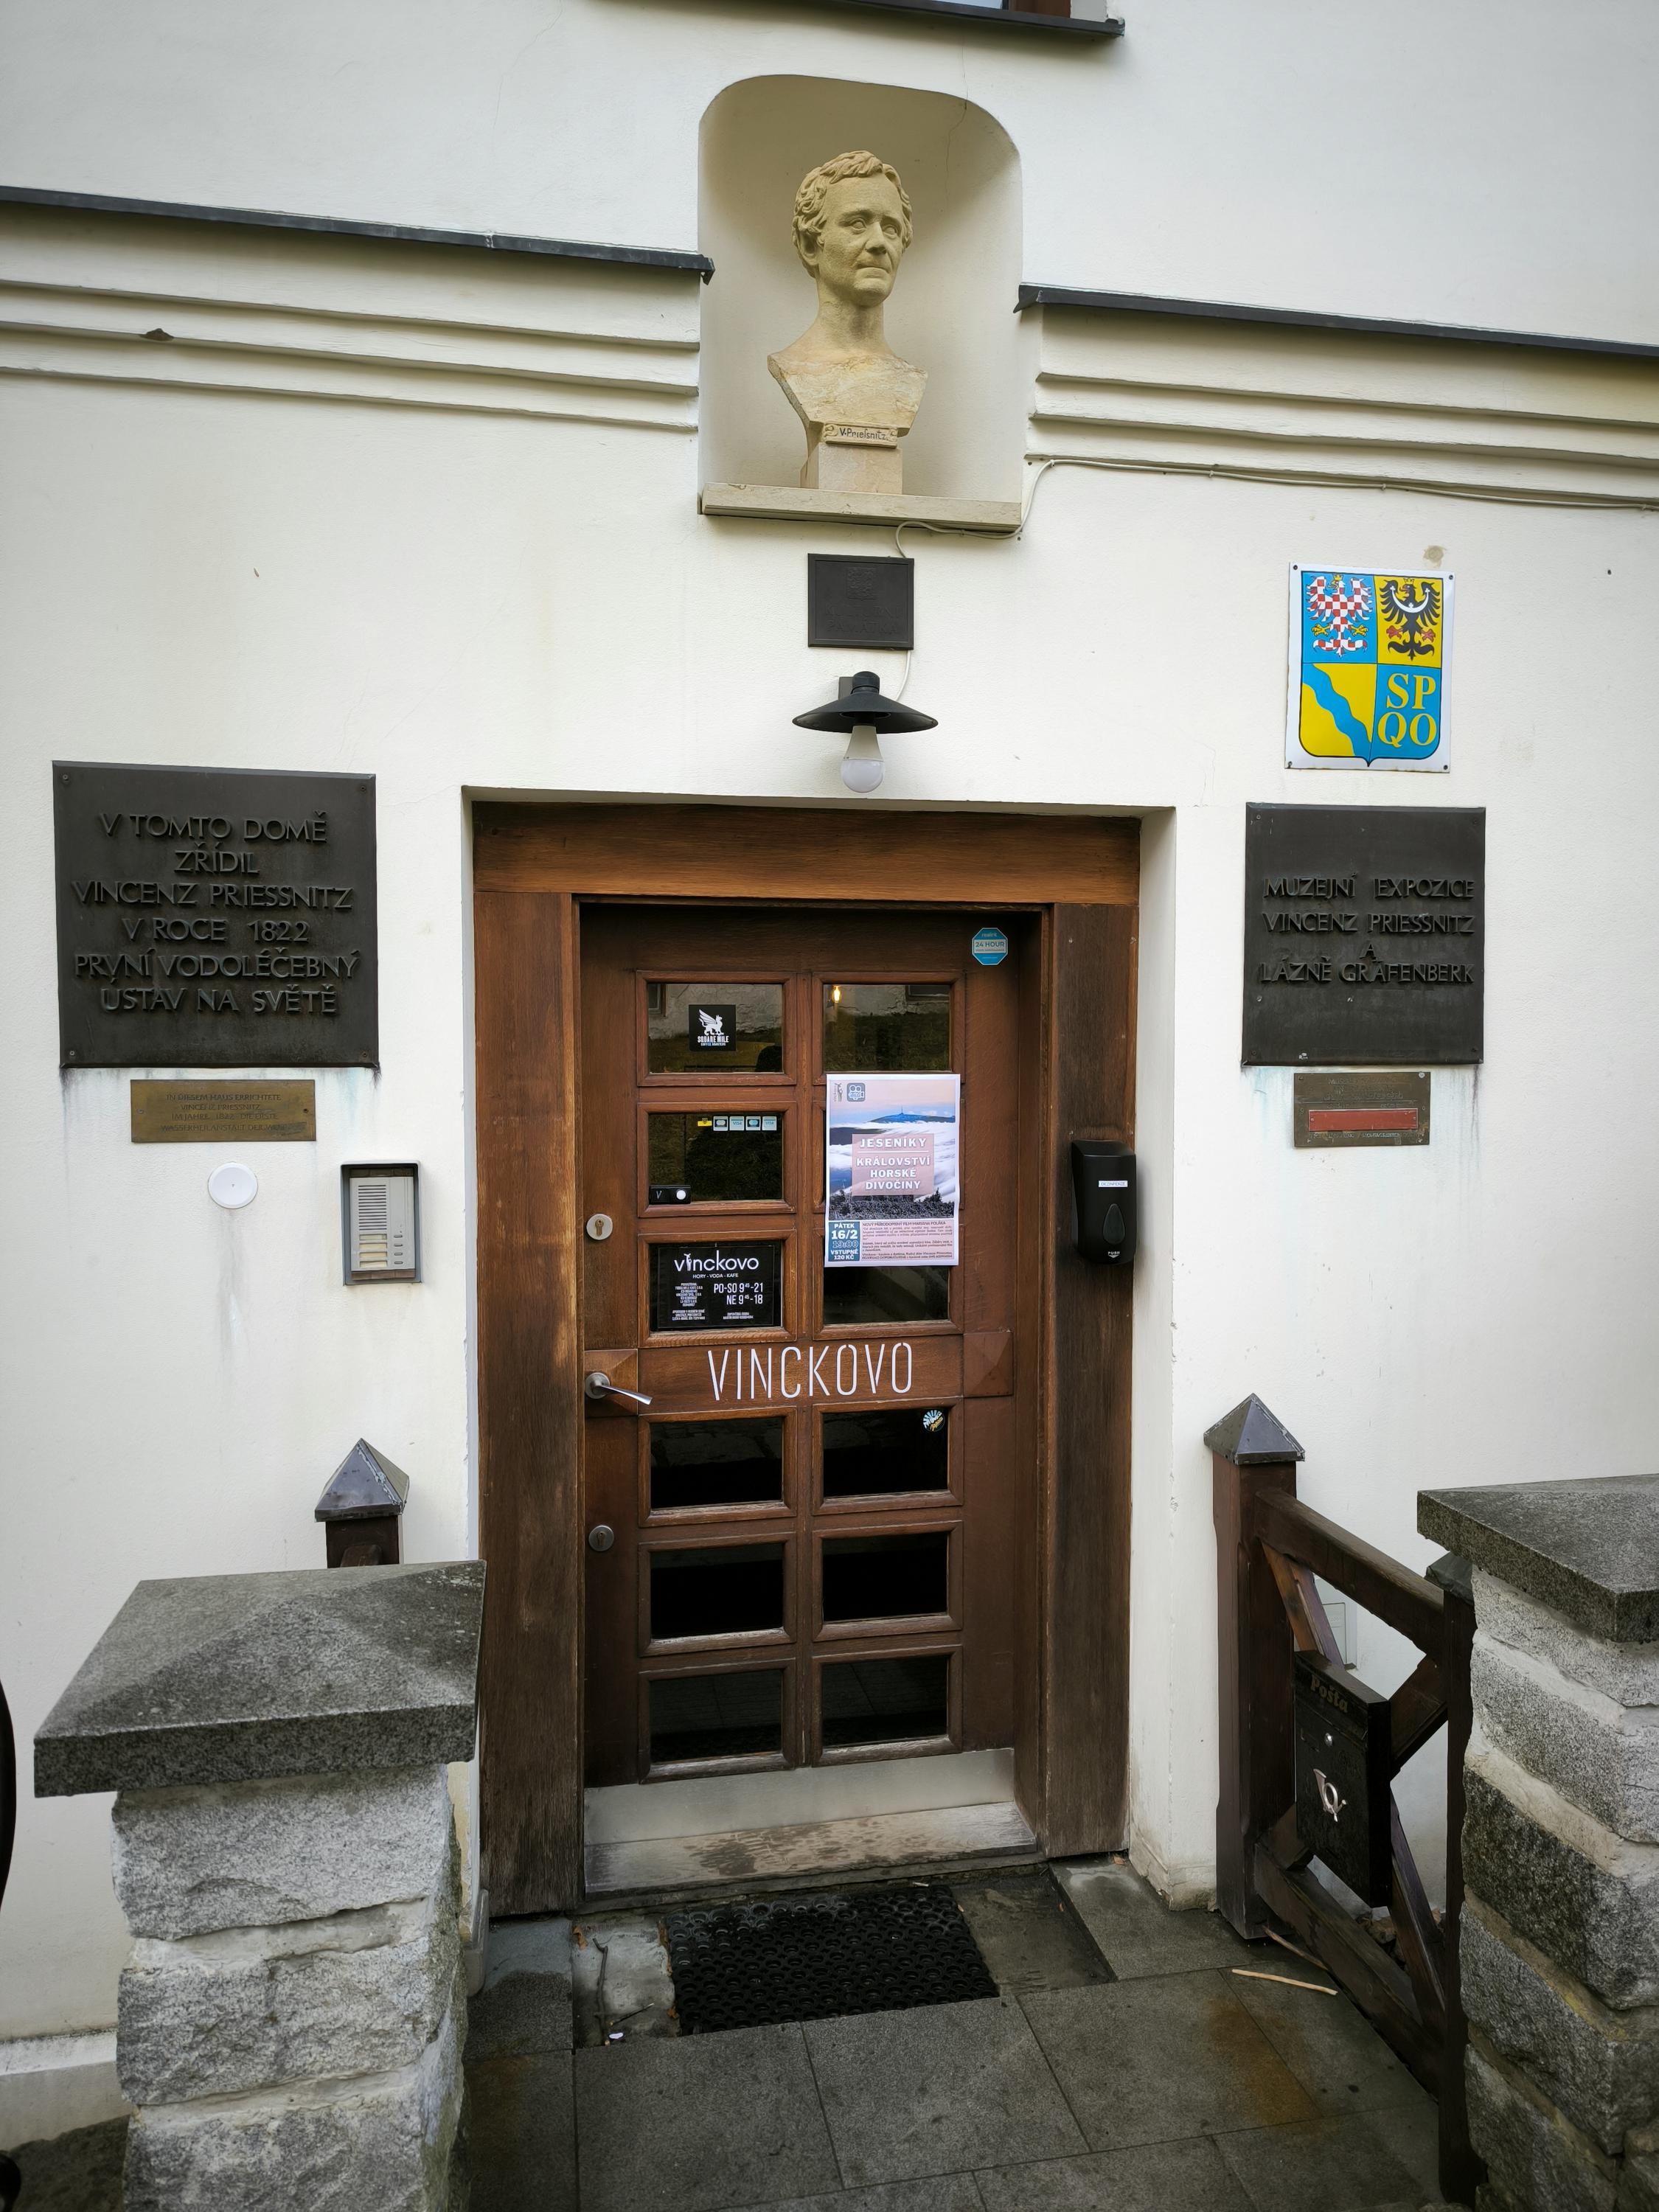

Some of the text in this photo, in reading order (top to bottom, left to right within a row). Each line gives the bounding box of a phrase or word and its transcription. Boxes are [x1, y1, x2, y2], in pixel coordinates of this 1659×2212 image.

[1386, 673, 1436, 709] SP
[1377, 712, 1437, 748] QO
[100, 811, 327, 843] V TOMTO DOMĚ
[173, 842, 260, 874] ZŘÍDIL
[73, 882, 355, 909] VINCENZ PRIESSNITZ
[1263, 872, 1475, 899] MUZEJNÍ EXPOZICE
[122, 918, 310, 942] V ROCE 1822
[1262, 913, 1475, 933] VINCENZ PRIESSNITZ
[76, 947, 360, 979] PRVNÍ VODOLÉČEBNÝ
[1363, 944, 1376, 960] A
[1259, 956, 1332, 982] LÁZNĚ
[100, 977, 338, 1014] ÚSTAV NA SVĚTĚ
[860, 1136, 927, 1148] JESENÍKY
[856, 1157, 931, 1166] KRÁLOVSTVÍ
[870, 1168, 917, 1178] HORSKÉ
[866, 1179, 921, 1190] DIVOČINY
[832, 1229, 858, 1239] 16/2
[832, 1240, 859, 1248] 19:00
[714, 1283, 737, 1293] PO-SO
[726, 1295, 737, 1305] NE
[708, 1342, 912, 1401] VINCKOVO
